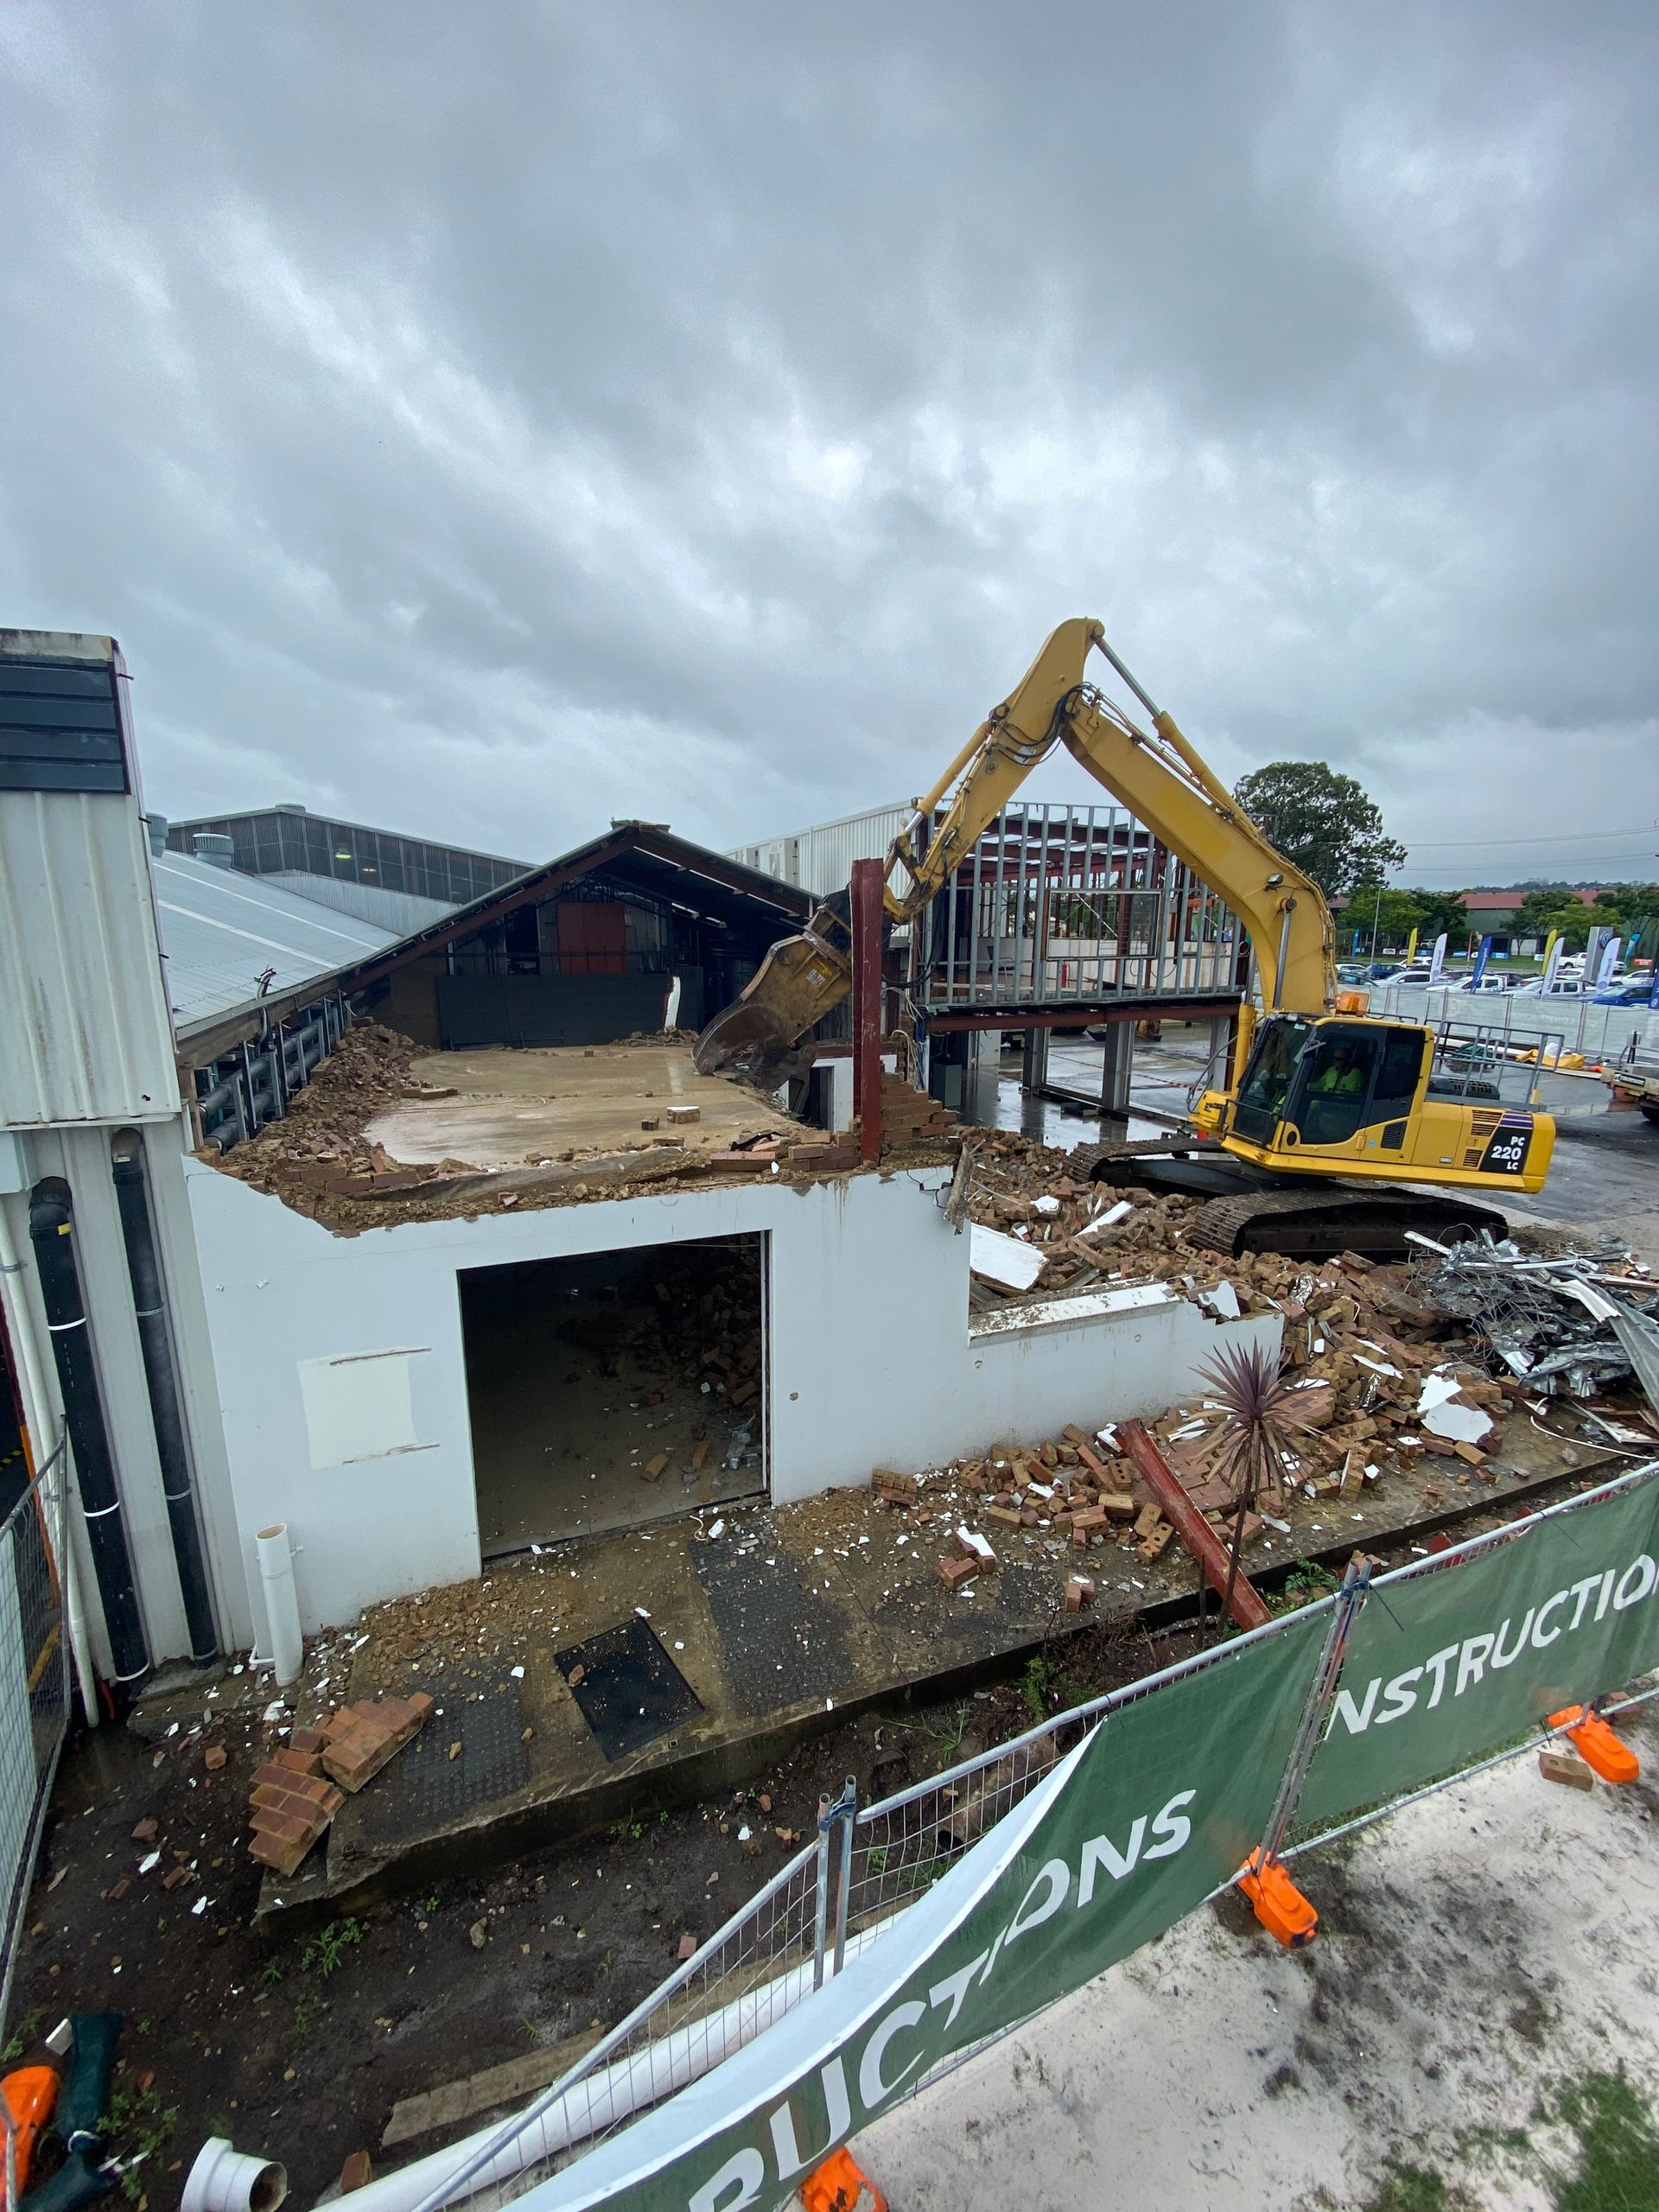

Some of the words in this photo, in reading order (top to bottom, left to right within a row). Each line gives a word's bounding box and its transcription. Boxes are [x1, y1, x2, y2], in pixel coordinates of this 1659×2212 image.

[1604, 958, 1612, 977] Amarok
[1510, 1135, 1525, 1146] PC
[1491, 1146, 1522, 1160] 220
[1506, 1161, 1518, 1170] LC
[1324, 1554, 1659, 1741] NSTRUCTIO
